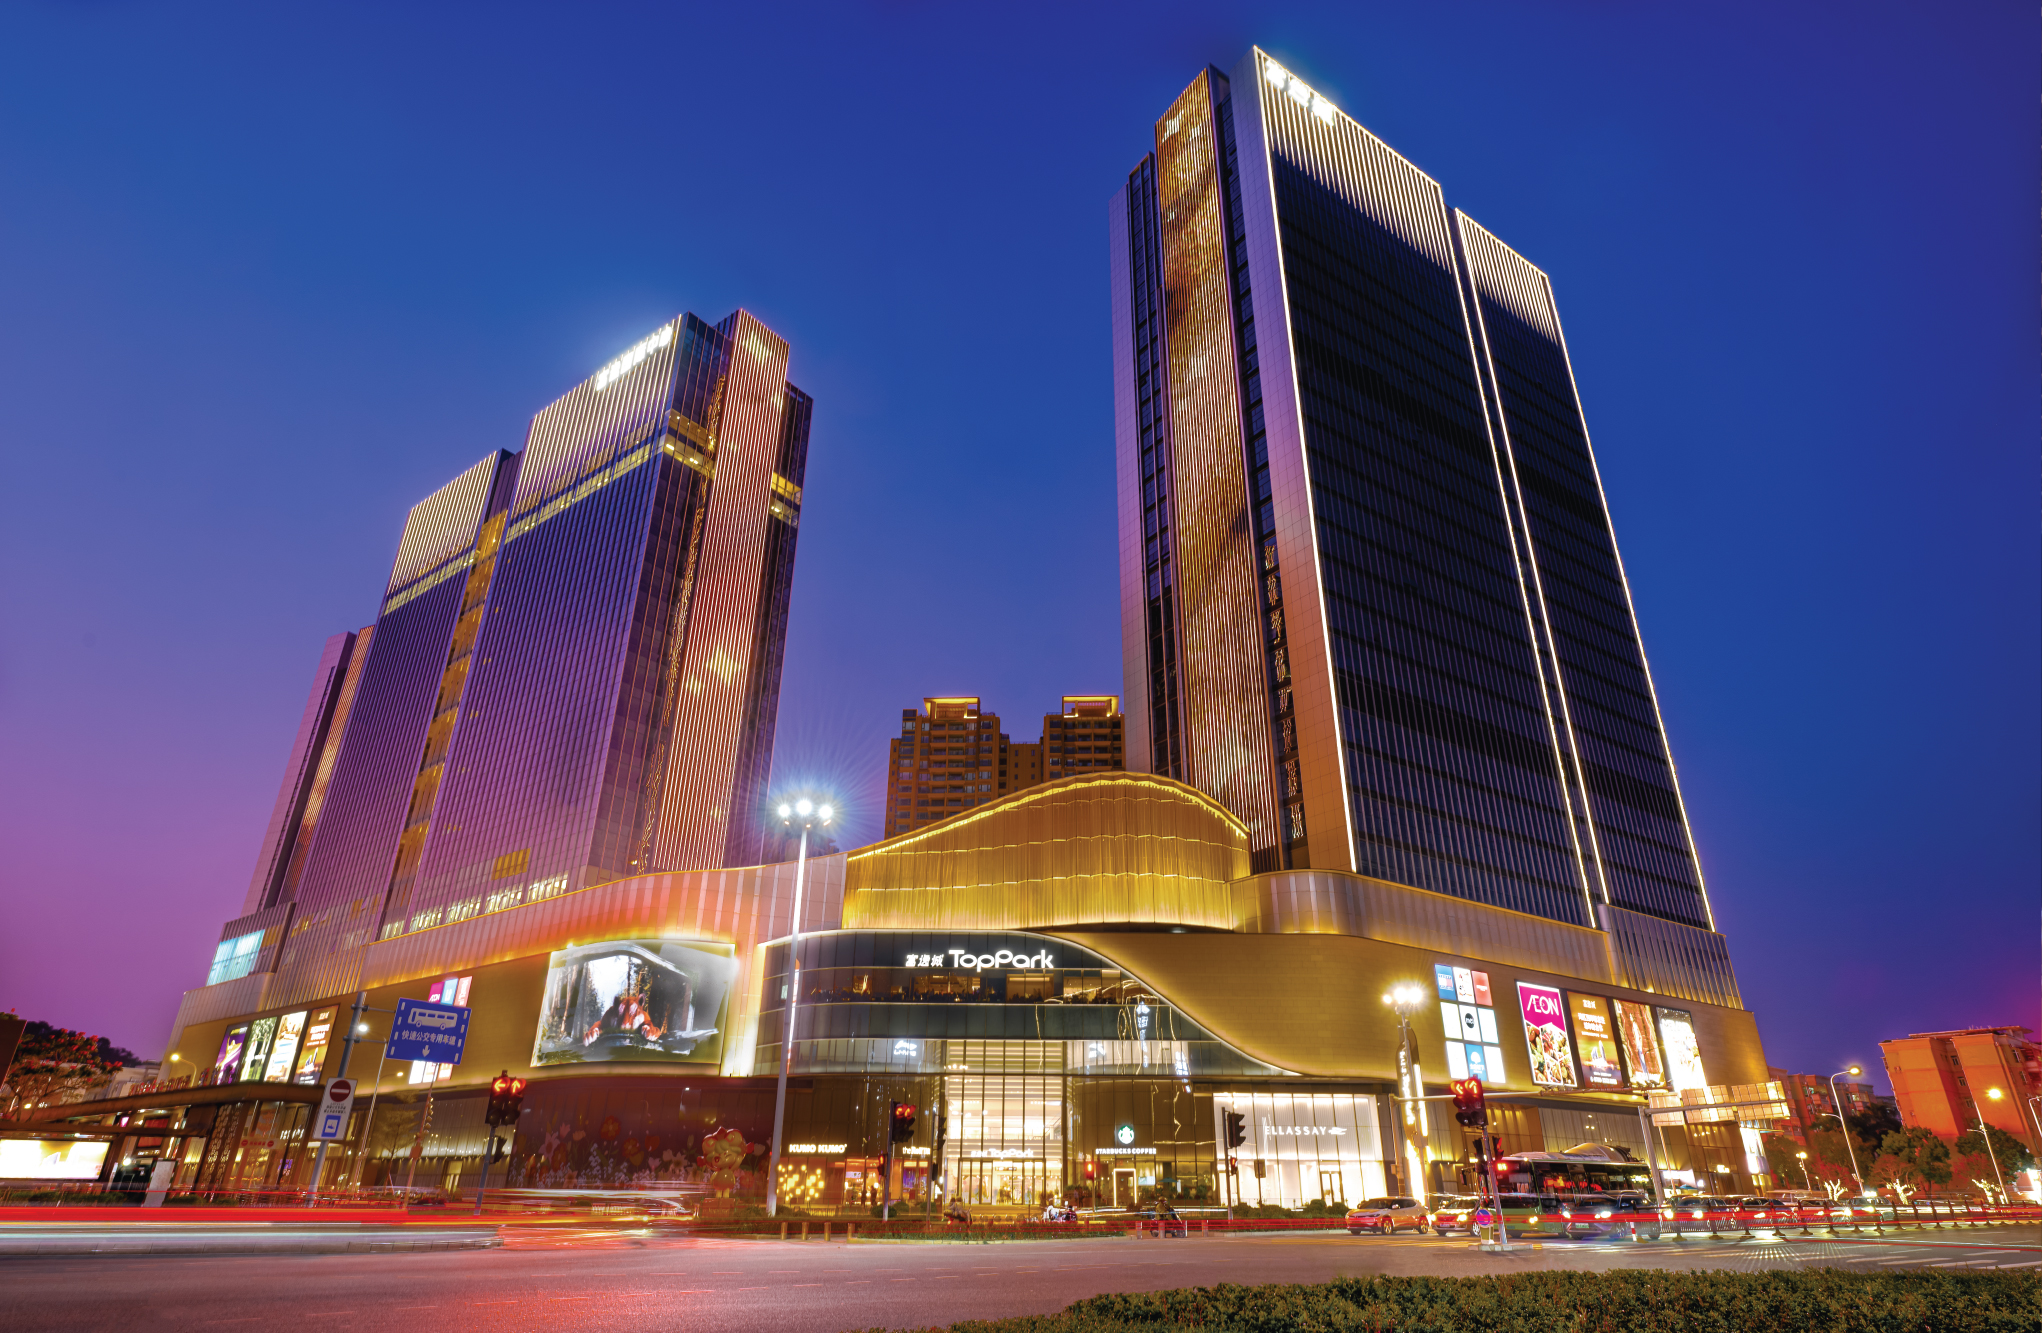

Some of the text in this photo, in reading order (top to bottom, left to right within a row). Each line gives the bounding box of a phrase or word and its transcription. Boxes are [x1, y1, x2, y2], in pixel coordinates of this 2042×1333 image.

[948, 949, 1054, 973] TopPark
[401, 1029, 457, 1046] 快速公交专用车道
[1264, 1125, 1327, 1136] ELLASSAY
[789, 1143, 846, 1153] KUMO KUMO
[988, 1147, 1034, 1160] TopPark
[1095, 1147, 1157, 1155] STARBUCKS COFFEE
